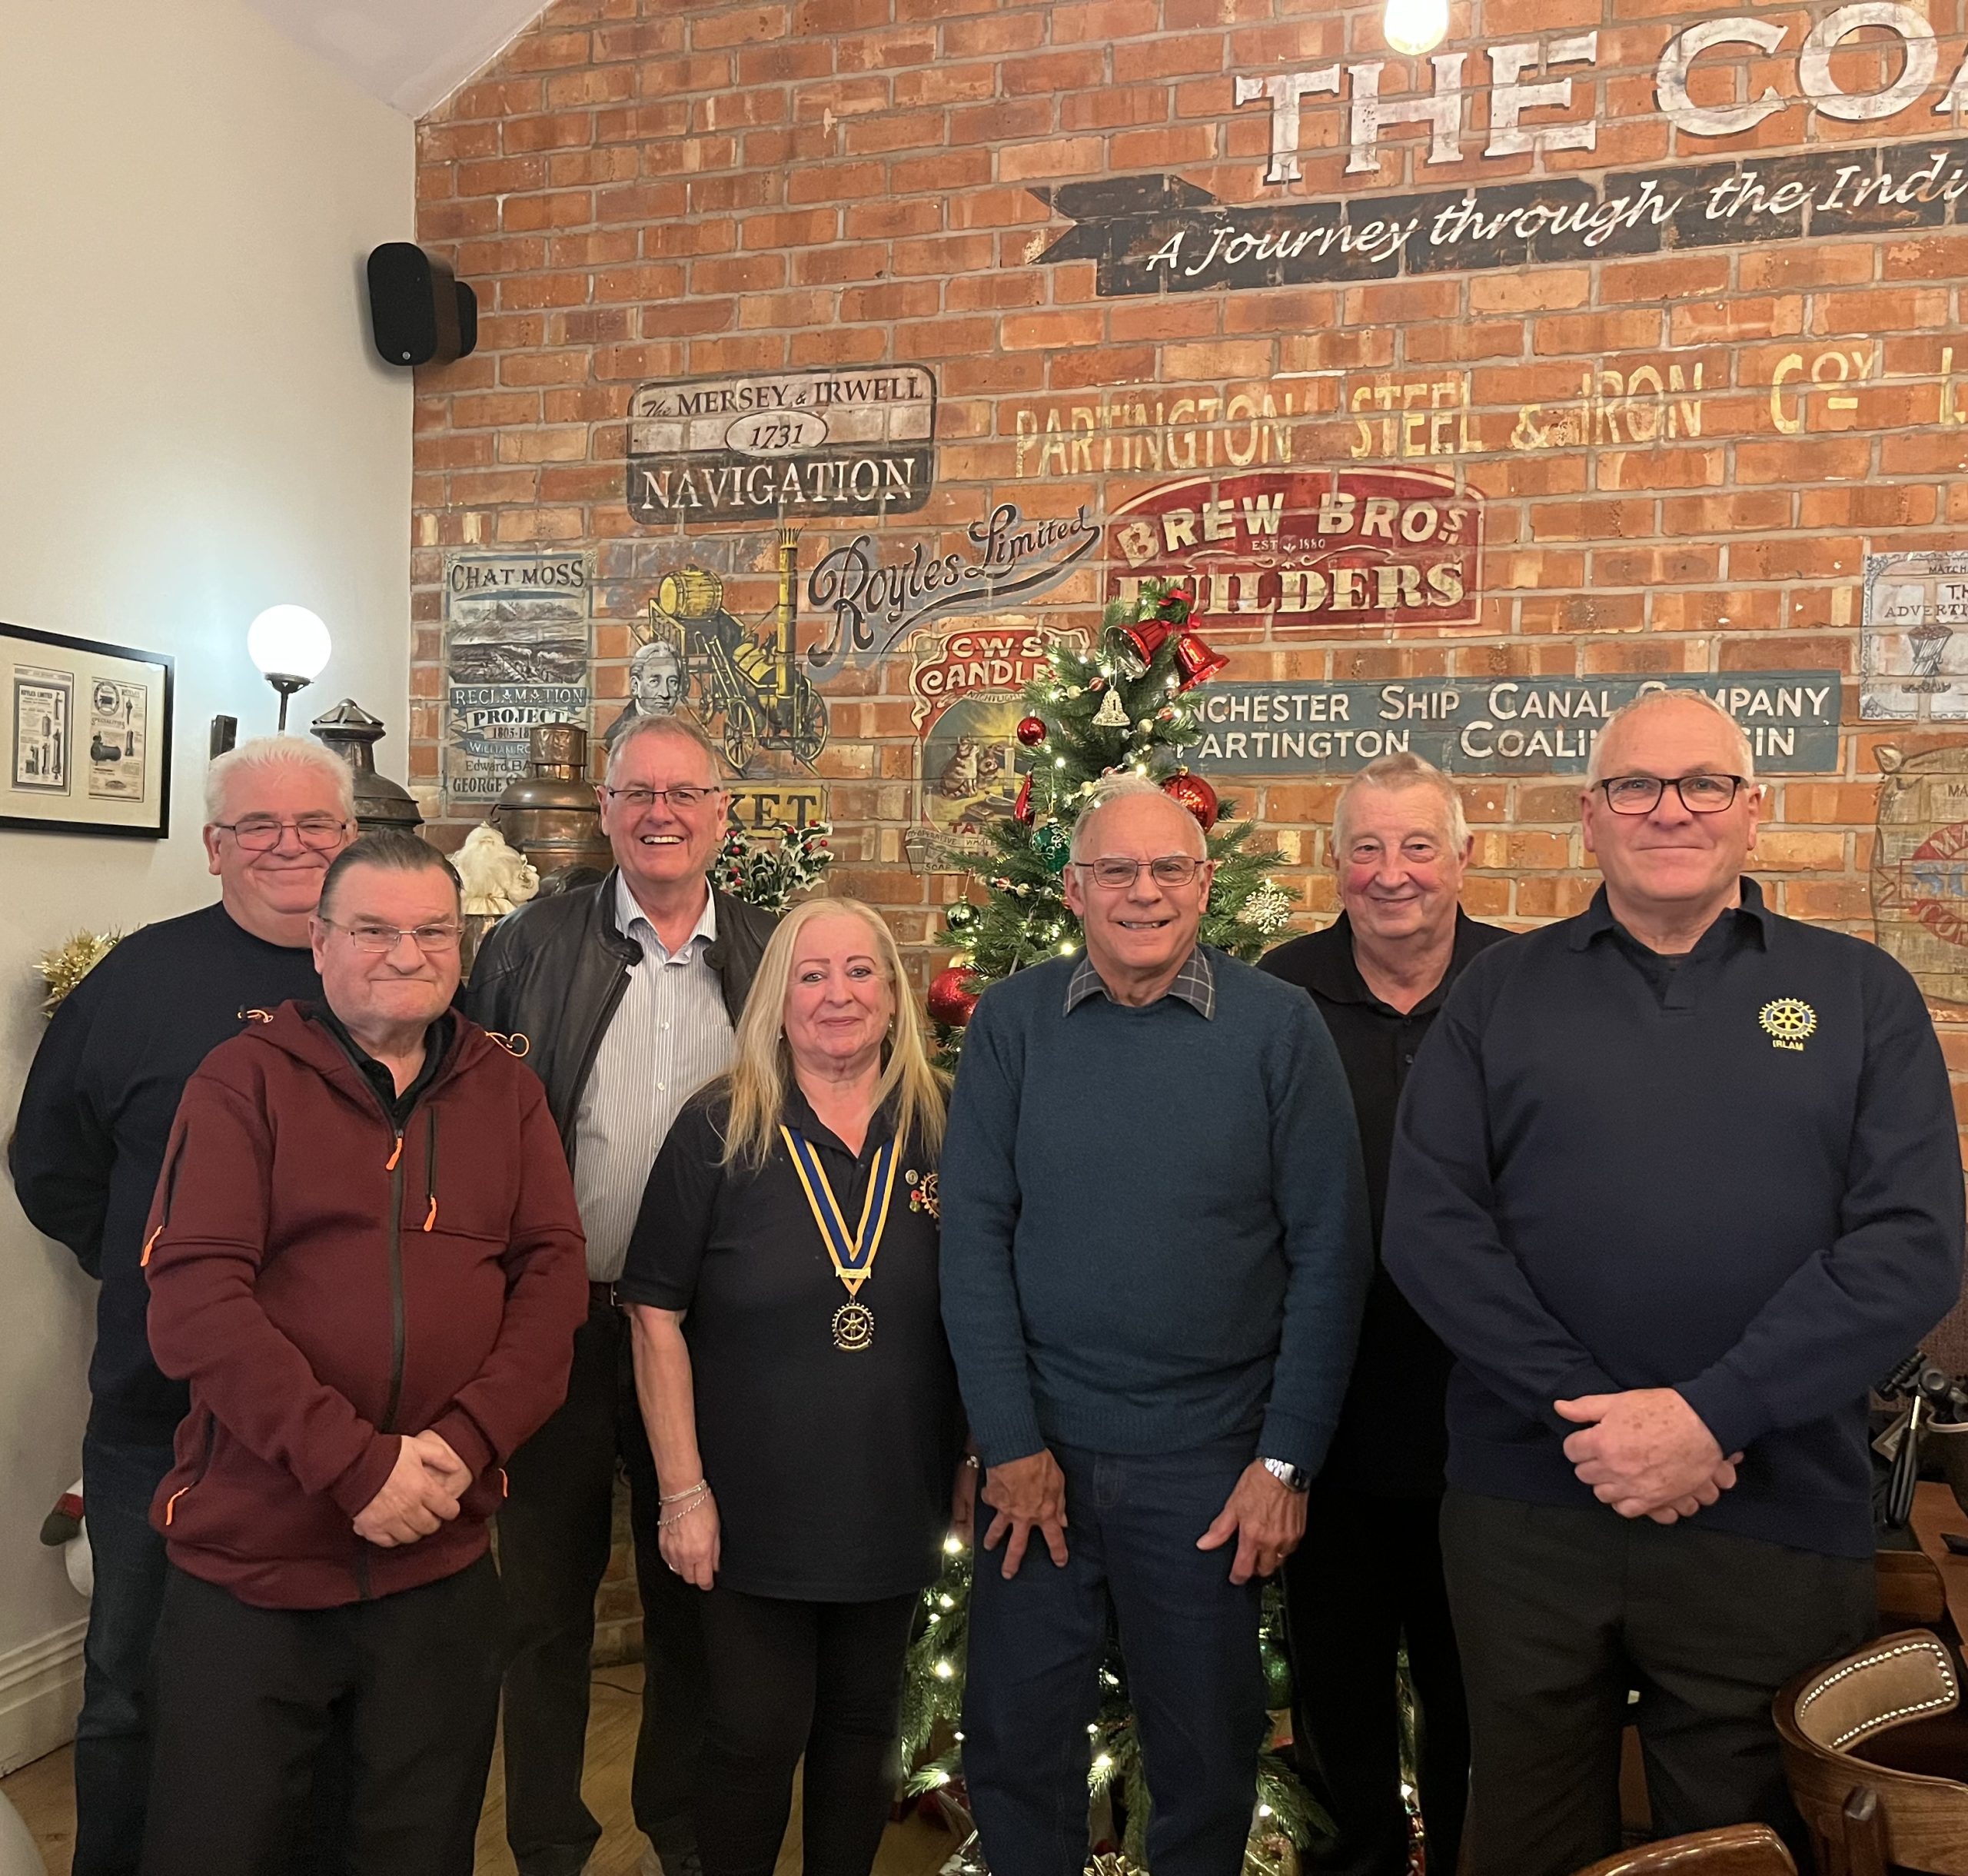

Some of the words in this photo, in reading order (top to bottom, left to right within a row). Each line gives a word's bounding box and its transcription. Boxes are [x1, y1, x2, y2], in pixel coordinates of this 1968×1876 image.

[1235, 30, 1597, 183] THE
[1146, 230, 1186, 272] A
[1185, 216, 1418, 277] Journey
[1429, 179, 1684, 247] through
[1705, 171, 1818, 220] the
[641, 399, 672, 417] The
[676, 384, 789, 415] MERSEY
[795, 391, 807, 405] &
[813, 376, 924, 404] IRWELL
[749, 424, 804, 450] 1731
[1015, 392, 1293, 478] PARTINGTON
[1349, 381, 1484, 458] STEEL
[1510, 404, 1550, 451] &
[1580, 361, 1704, 446] IRON
[640, 457, 916, 510] NAVIGATION
[1116, 492, 1285, 569] BREW
[1251, 540, 1278, 552] EST
[1298, 537, 1326, 550] 1880
[450, 564, 515, 593] CHAT
[522, 559, 585, 588] MOSS
[806, 534, 961, 668] Royles
[964, 502, 1101, 580] Limited
[1883, 604, 1968, 618] ADVERTI
[921, 659, 1048, 695] CANDLE
[455, 688, 584, 706] RECLAMATION
[1186, 693, 1350, 723] NCHESTER
[1378, 684, 1460, 720] SHIP
[1488, 682, 1615, 720] CANAL
[473, 708, 566, 727] PROJECT
[493, 727, 530, 740] 1805-18
[469, 741, 515, 754] WILLIAM
[1176, 729, 1410, 760] ARTINGTON
[1460, 720, 1598, 758] COALI
[465, 760, 507, 772] Edward
[453, 777, 503, 793] GEORGE
[726, 793, 817, 831] KET
[1772, 1039, 1804, 1051] IRLAM
